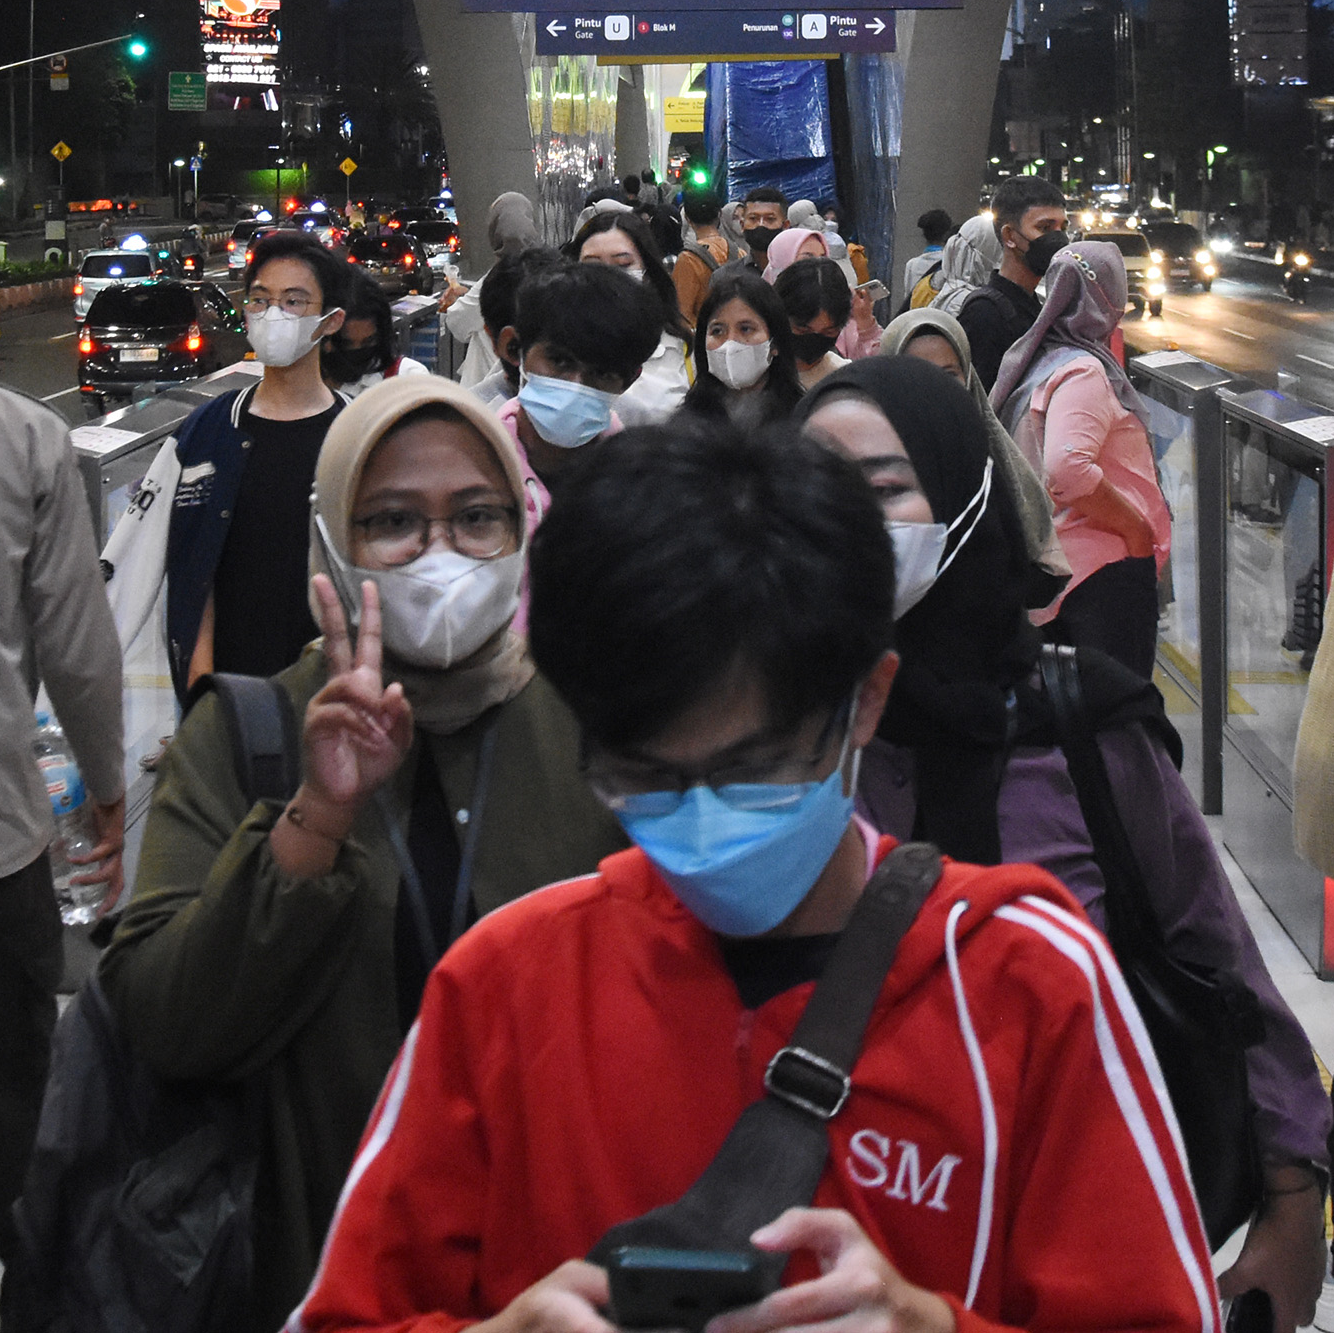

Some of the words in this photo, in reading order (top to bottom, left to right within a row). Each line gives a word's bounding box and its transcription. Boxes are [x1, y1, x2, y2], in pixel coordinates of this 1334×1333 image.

[575, 18, 601, 28] Pintu
[829, 16, 857, 26] Pintu
[612, 22, 621, 34] U
[653, 24, 668, 32] Blok
[669, 24, 676, 32] M
[743, 23, 778, 32] Penurunan
[809, 21, 819, 32] A
[575, 30, 593, 39] Gate
[838, 28, 857, 37] Gate
[845, 1127, 963, 1212] SM
